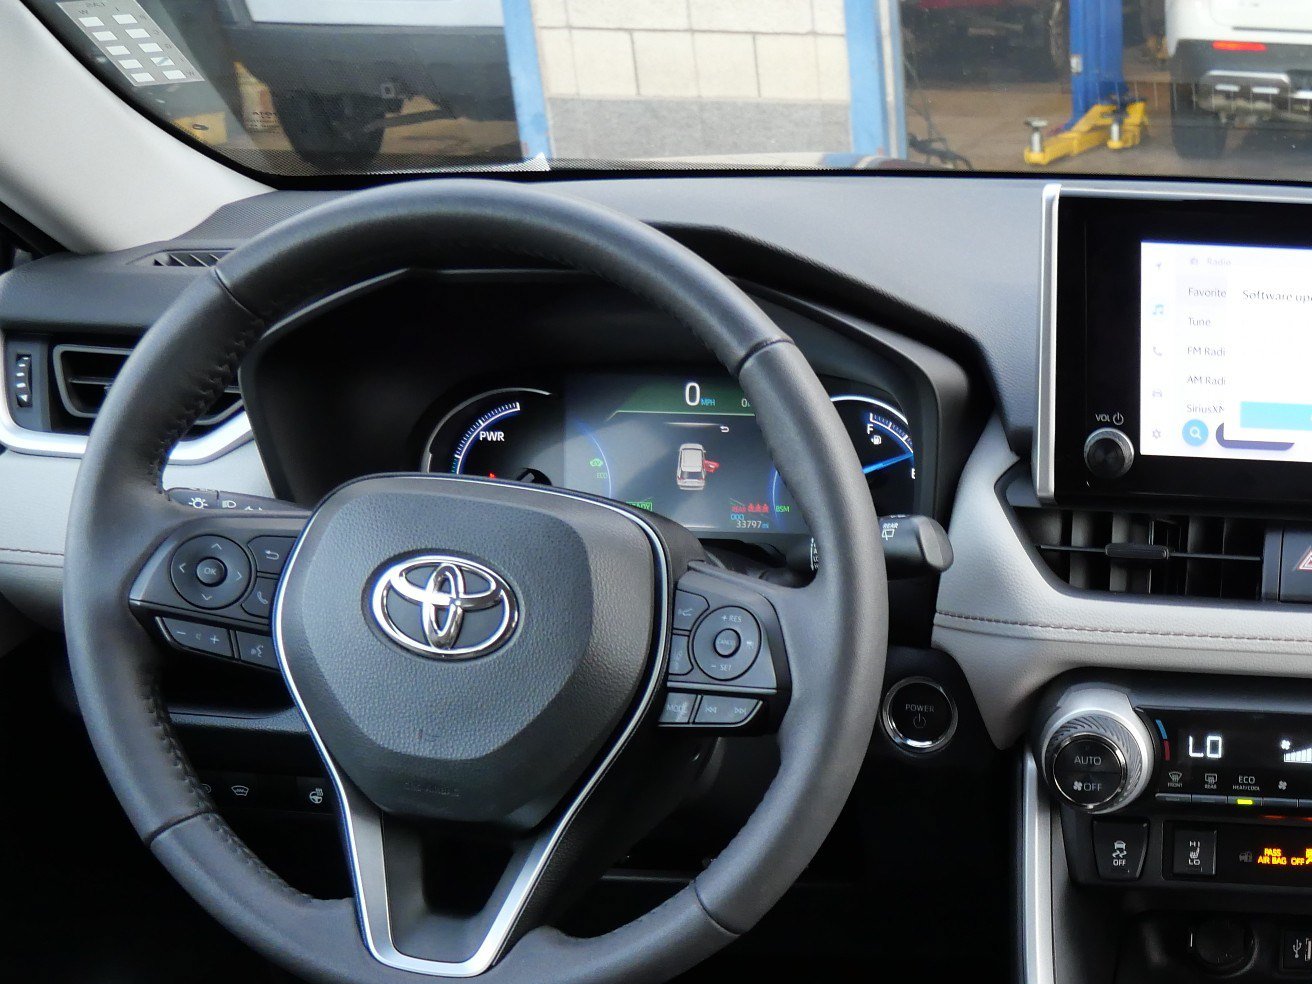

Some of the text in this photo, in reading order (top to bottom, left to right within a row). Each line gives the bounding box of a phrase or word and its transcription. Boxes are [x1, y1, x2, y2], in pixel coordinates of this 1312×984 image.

[1242, 289, 1293, 301] Software
[1188, 316, 1211, 327] Tune
[1187, 346, 1226, 357] FM Radi
[1187, 375, 1226, 386] AM Radi
[1095, 413, 1111, 422] VOL
[867, 423, 874, 435] F
[480, 431, 505, 442] PWR
[775, 505, 790, 513] BSM
[736, 520, 762, 529] 33797
[204, 567, 217, 575] OK
[729, 615, 742, 623] RES
[905, 703, 935, 713] POWER
[1189, 735, 1222, 758] LO
[1074, 755, 1102, 766] AUTO
[1238, 775, 1256, 784] ECO
[1083, 782, 1103, 792] OFF
[1264, 848, 1281, 857] PASS
[1112, 859, 1127, 867] OFF
[1188, 859, 1201, 867] LO
[1257, 855, 1305, 866] AIR BAG OFF
